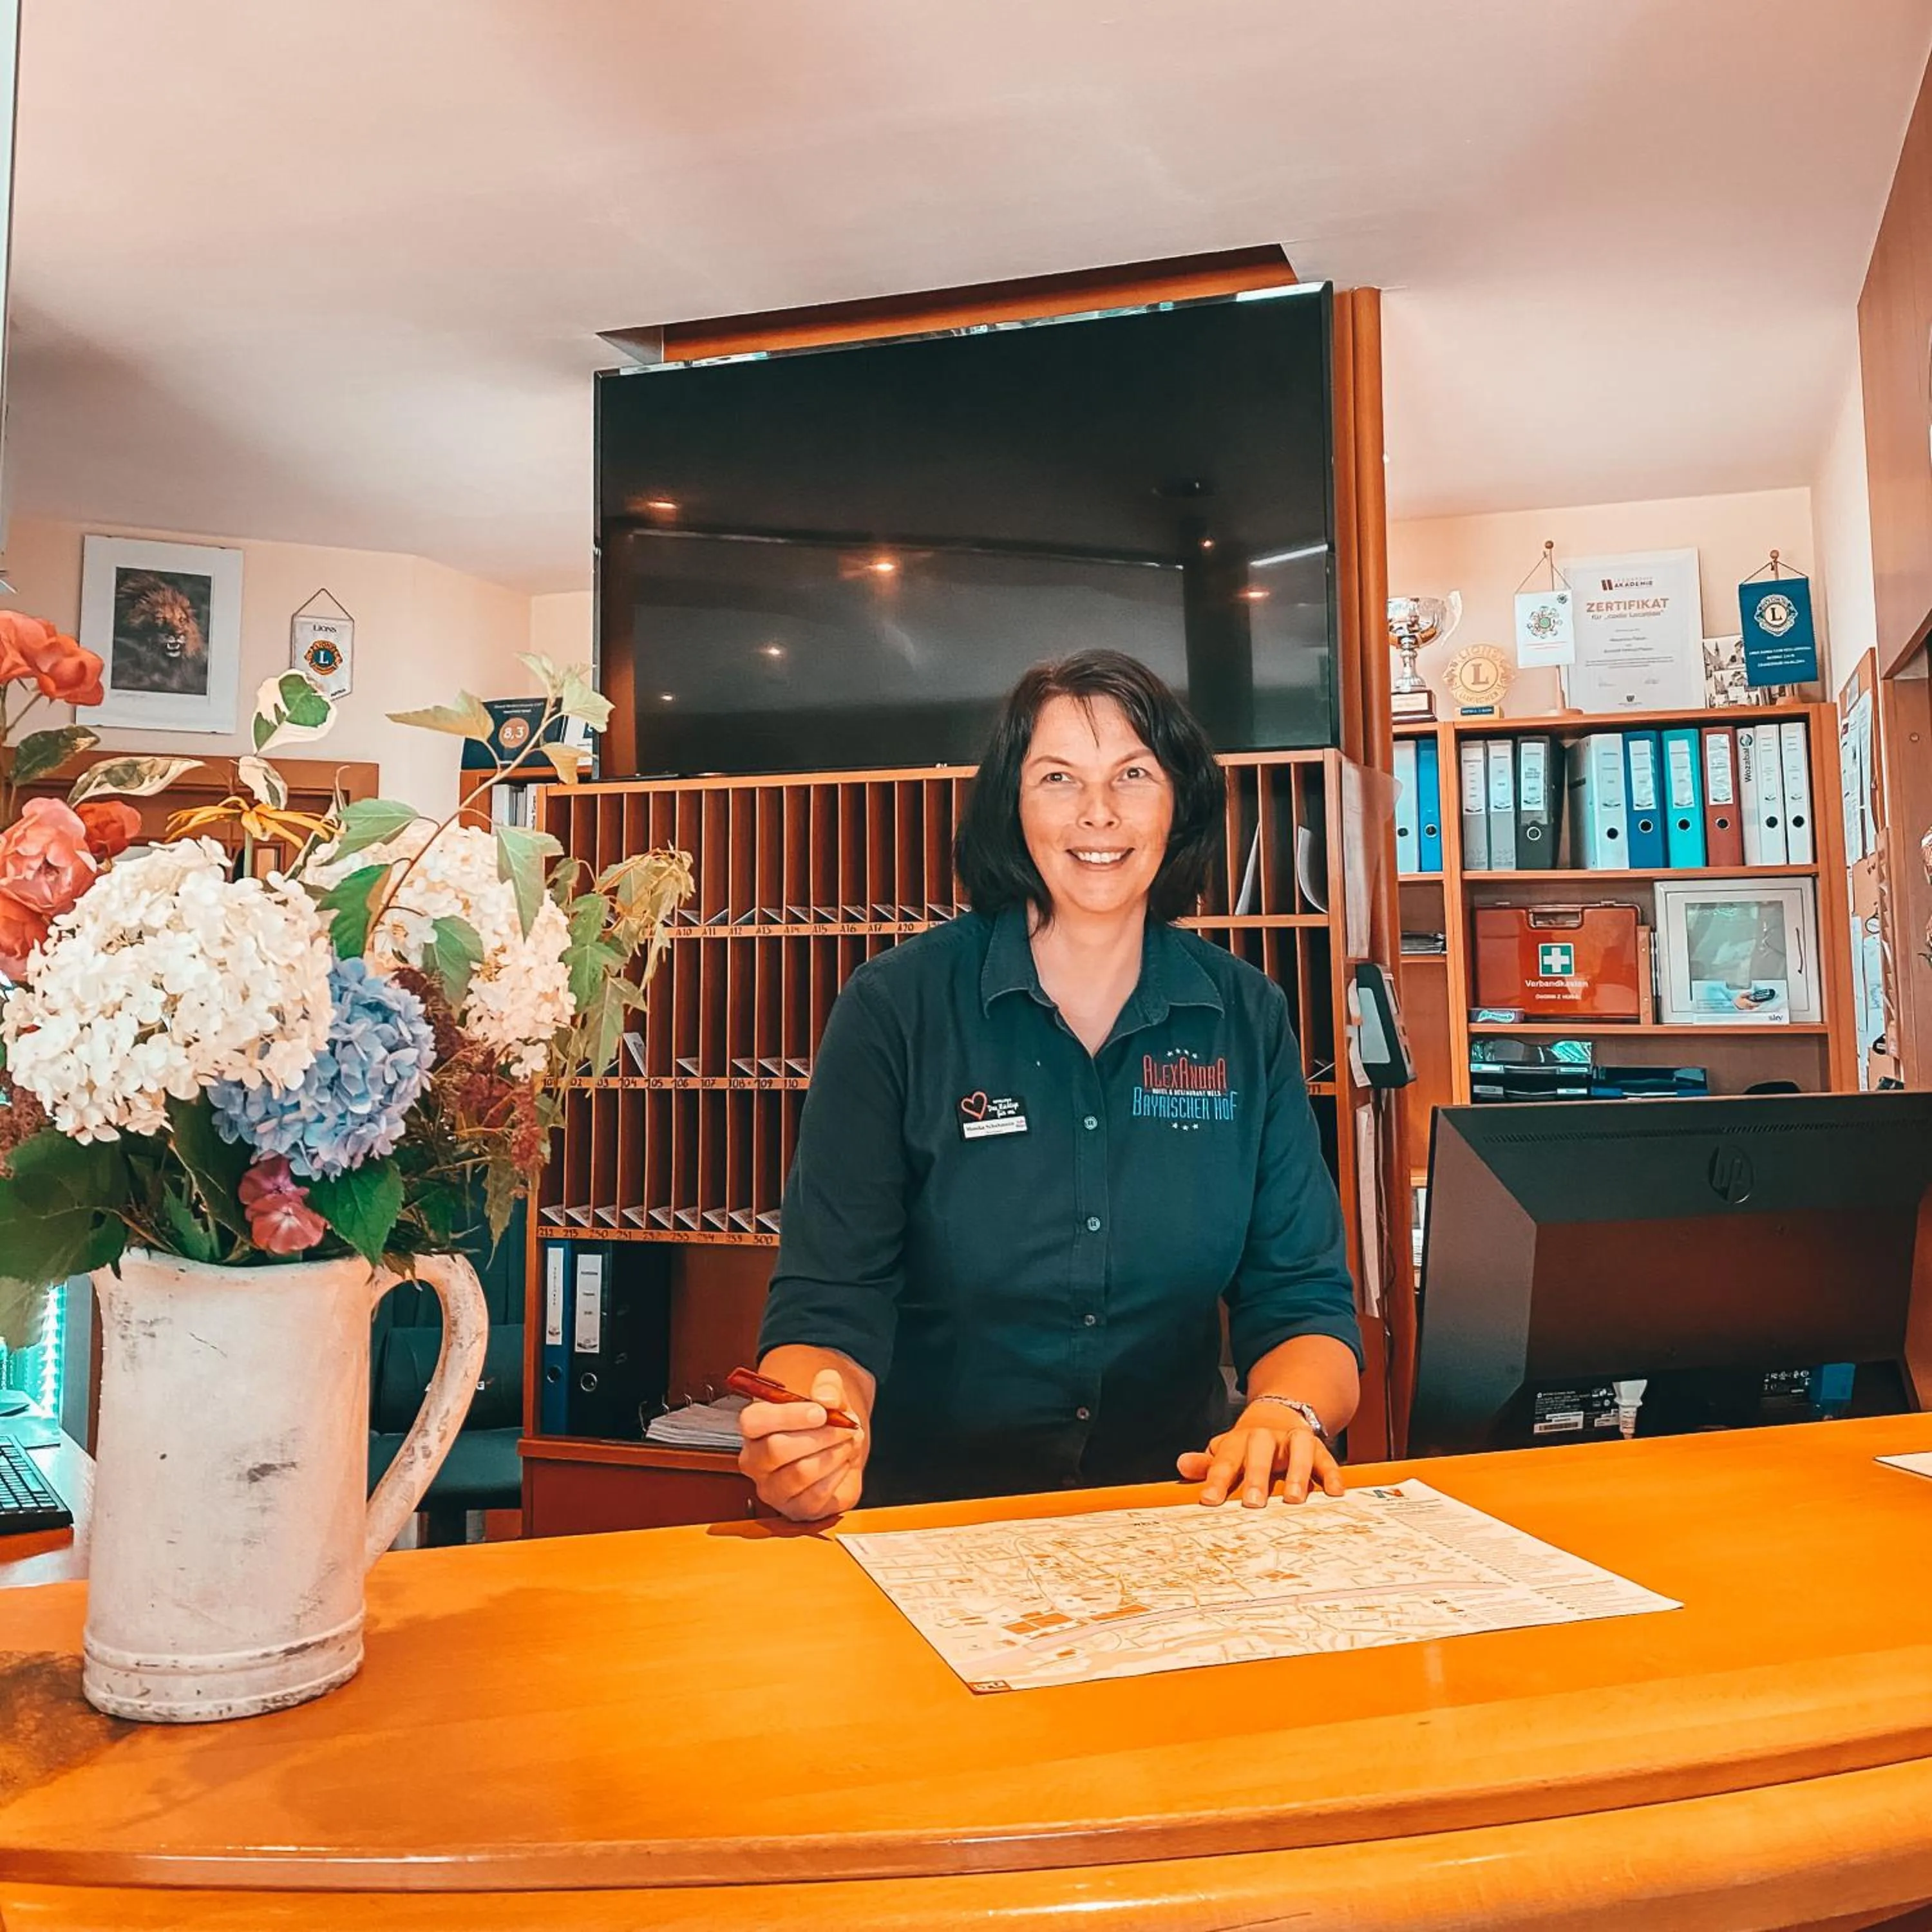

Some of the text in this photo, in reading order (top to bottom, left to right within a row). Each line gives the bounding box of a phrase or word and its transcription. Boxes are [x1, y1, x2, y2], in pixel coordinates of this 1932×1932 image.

[1615, 580, 1653, 588] AKADEMIE
[1587, 598, 1669, 612] ZERTIFIKAT
[503, 726, 524, 739] 8,3
[702, 927, 715, 936] A11
[618, 1078, 637, 1088] 104
[646, 1079, 663, 1088] 105
[671, 1079, 688, 1088] 106
[728, 1079, 746, 1088] 108
[754, 1079, 773, 1088] 109
[784, 1079, 799, 1088] 110
[1133, 1086, 1238, 1121] BAYRISCHER HOF
